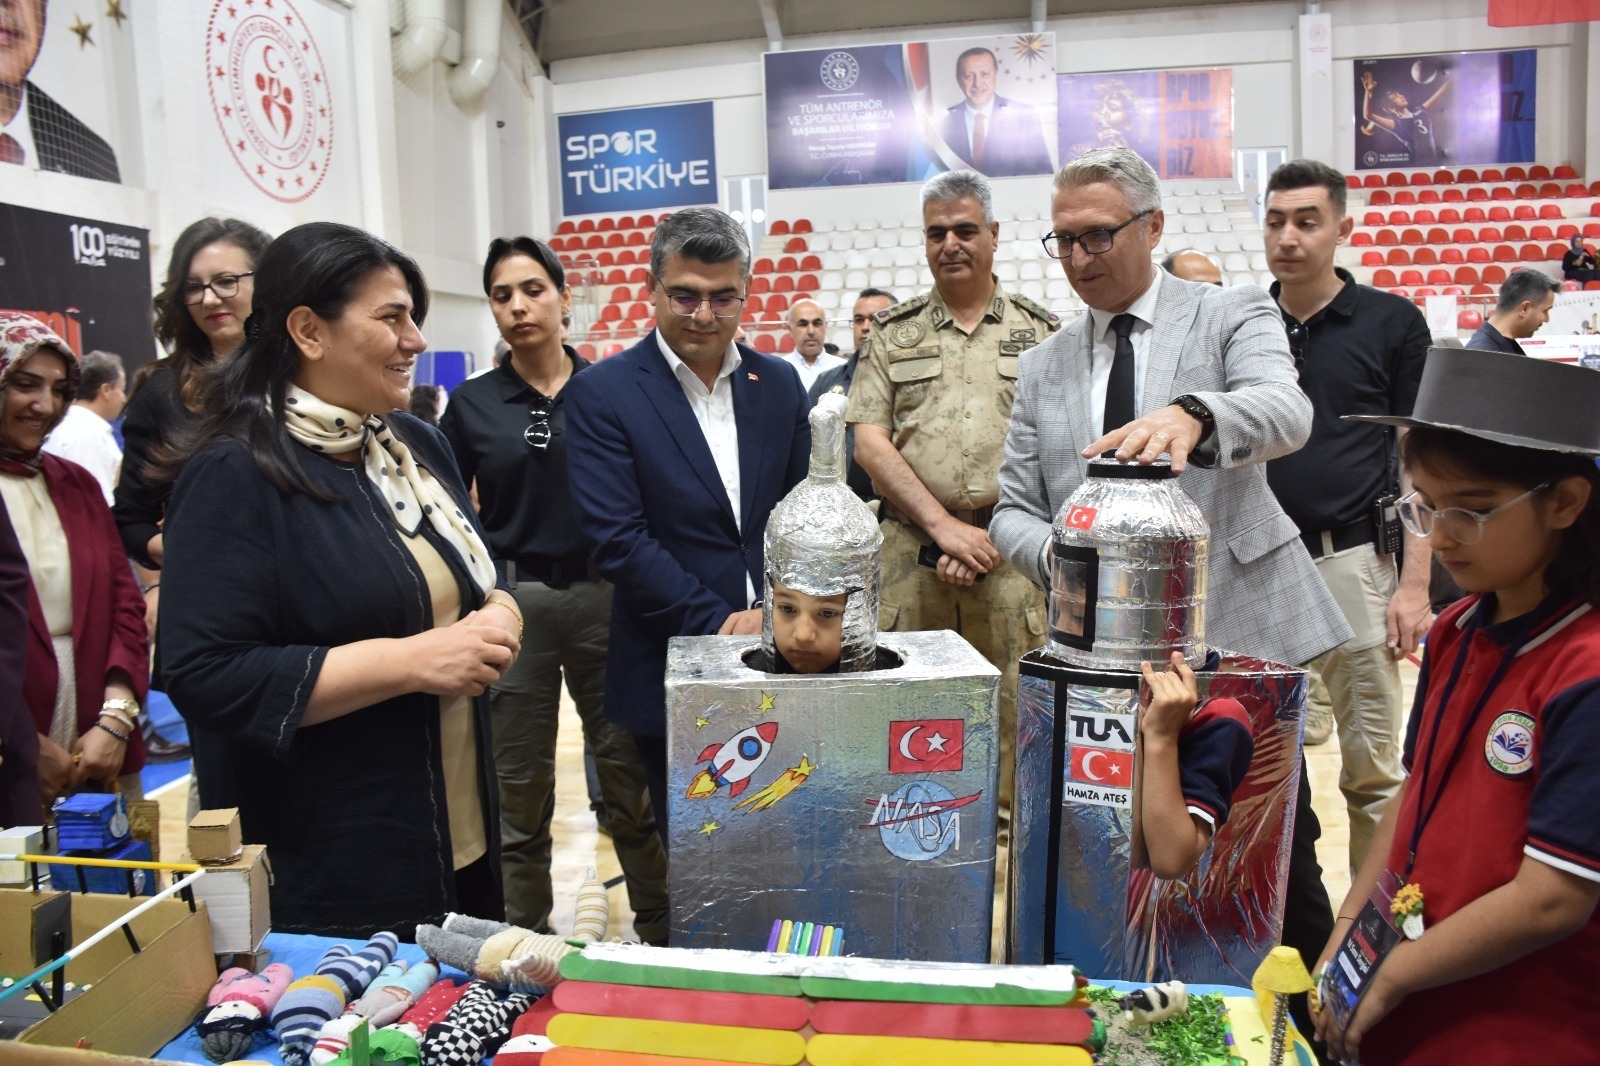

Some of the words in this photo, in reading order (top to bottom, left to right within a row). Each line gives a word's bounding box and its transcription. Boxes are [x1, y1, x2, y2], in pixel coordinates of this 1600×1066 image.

[799, 102, 823, 114] TÜM
[826, 99, 883, 112] ANTRENÖR
[787, 115, 802, 125] VE
[803, 110, 895, 125] SPORCULARIMIZA
[792, 125, 841, 137] BAŞARILAR
[842, 122, 892, 133] DİLİYORUM
[565, 128, 658, 162] SPOR
[567, 157, 710, 196] TÜRKİYE
[69, 223, 106, 262] 100
[1070, 714, 1133, 744] TUA
[1513, 714, 1536, 733] ARSLA
[1489, 756, 1509, 773] 1998
[1066, 786, 1100, 801] HAMZA
[1102, 792, 1128, 805] ATEŞ
[869, 792, 961, 851] NASA
